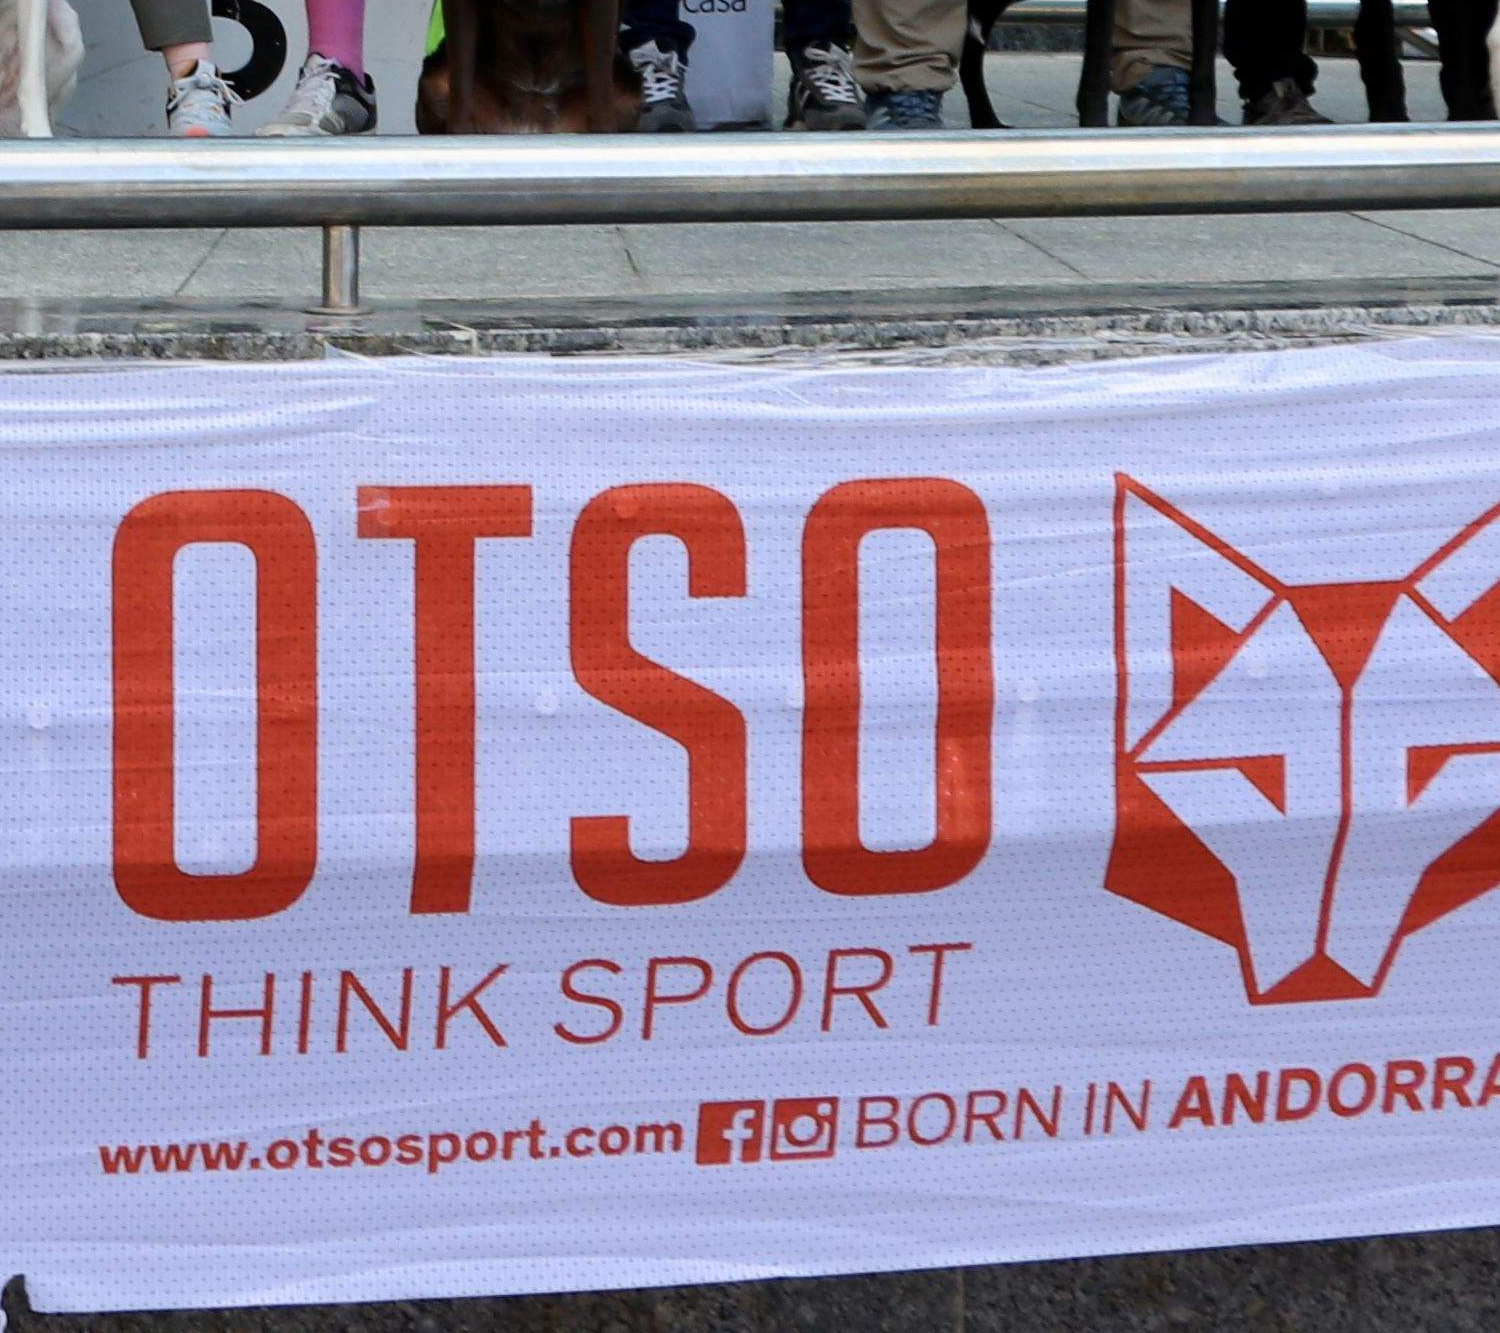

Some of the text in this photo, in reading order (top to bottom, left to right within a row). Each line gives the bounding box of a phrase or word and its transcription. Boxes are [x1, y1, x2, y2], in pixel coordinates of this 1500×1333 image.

[110, 476, 995, 923] OTSO
[111, 941, 973, 1060] THINK SPORT
[98, 1118, 685, 1175] www.otsosport.com
[854, 1084, 1063, 1151] BORN
[1082, 1079, 1151, 1137] IN
